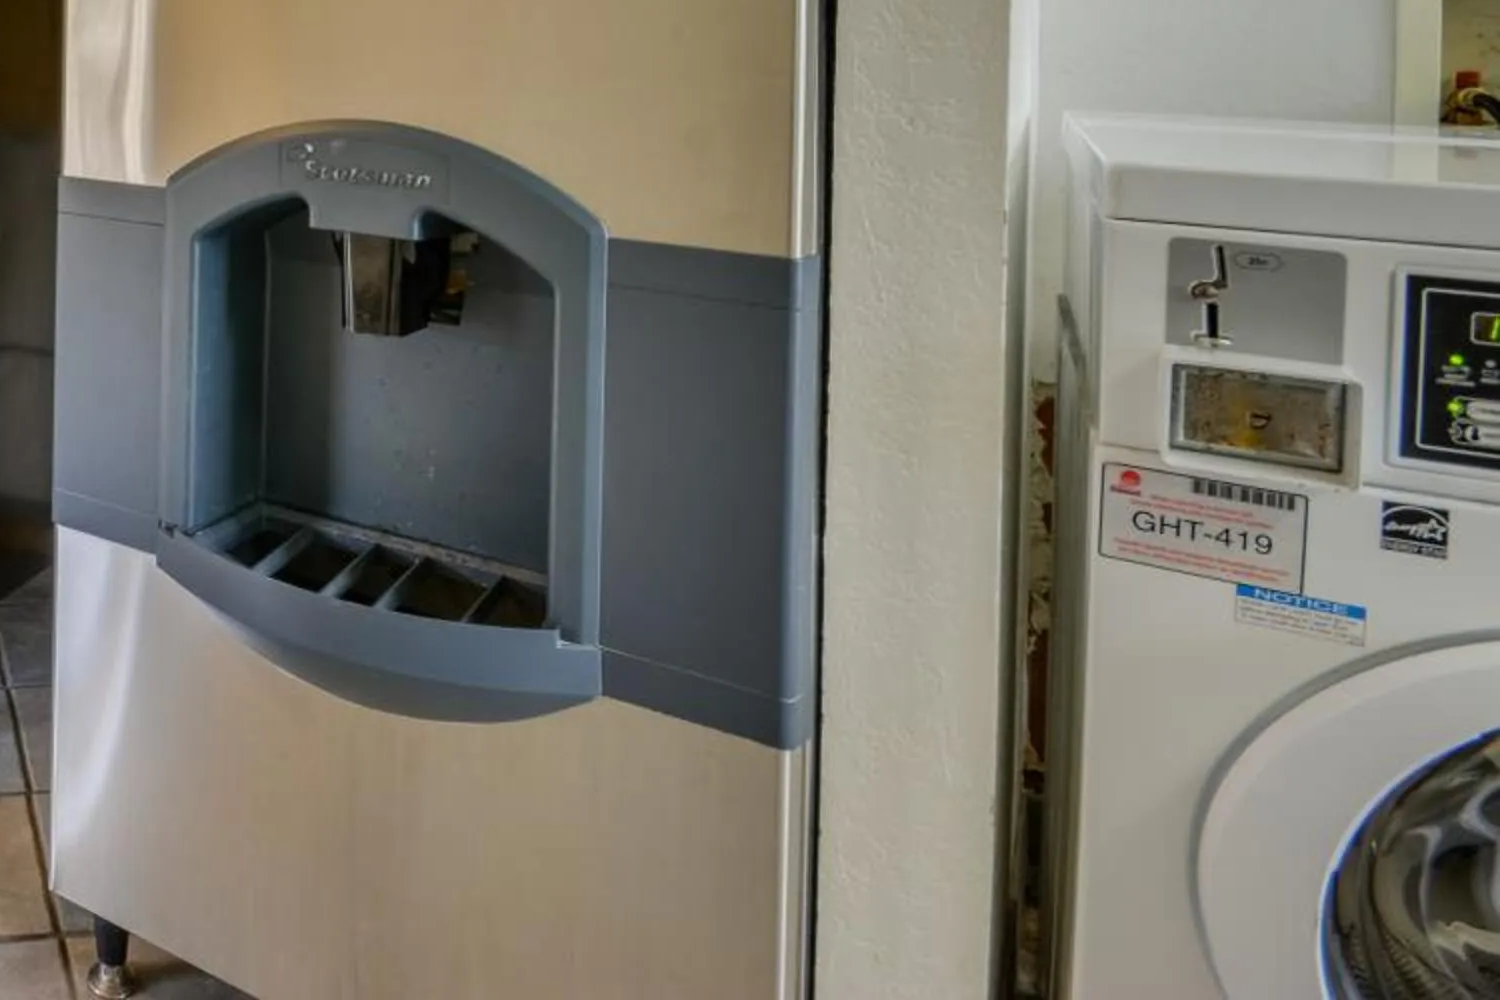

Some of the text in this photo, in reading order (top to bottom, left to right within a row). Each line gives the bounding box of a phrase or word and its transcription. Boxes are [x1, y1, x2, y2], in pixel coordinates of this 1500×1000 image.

[304, 159, 433, 189] Scotsman
[1132, 510, 1274, 555] GHT-419
[1254, 588, 1349, 613] NOTICE
